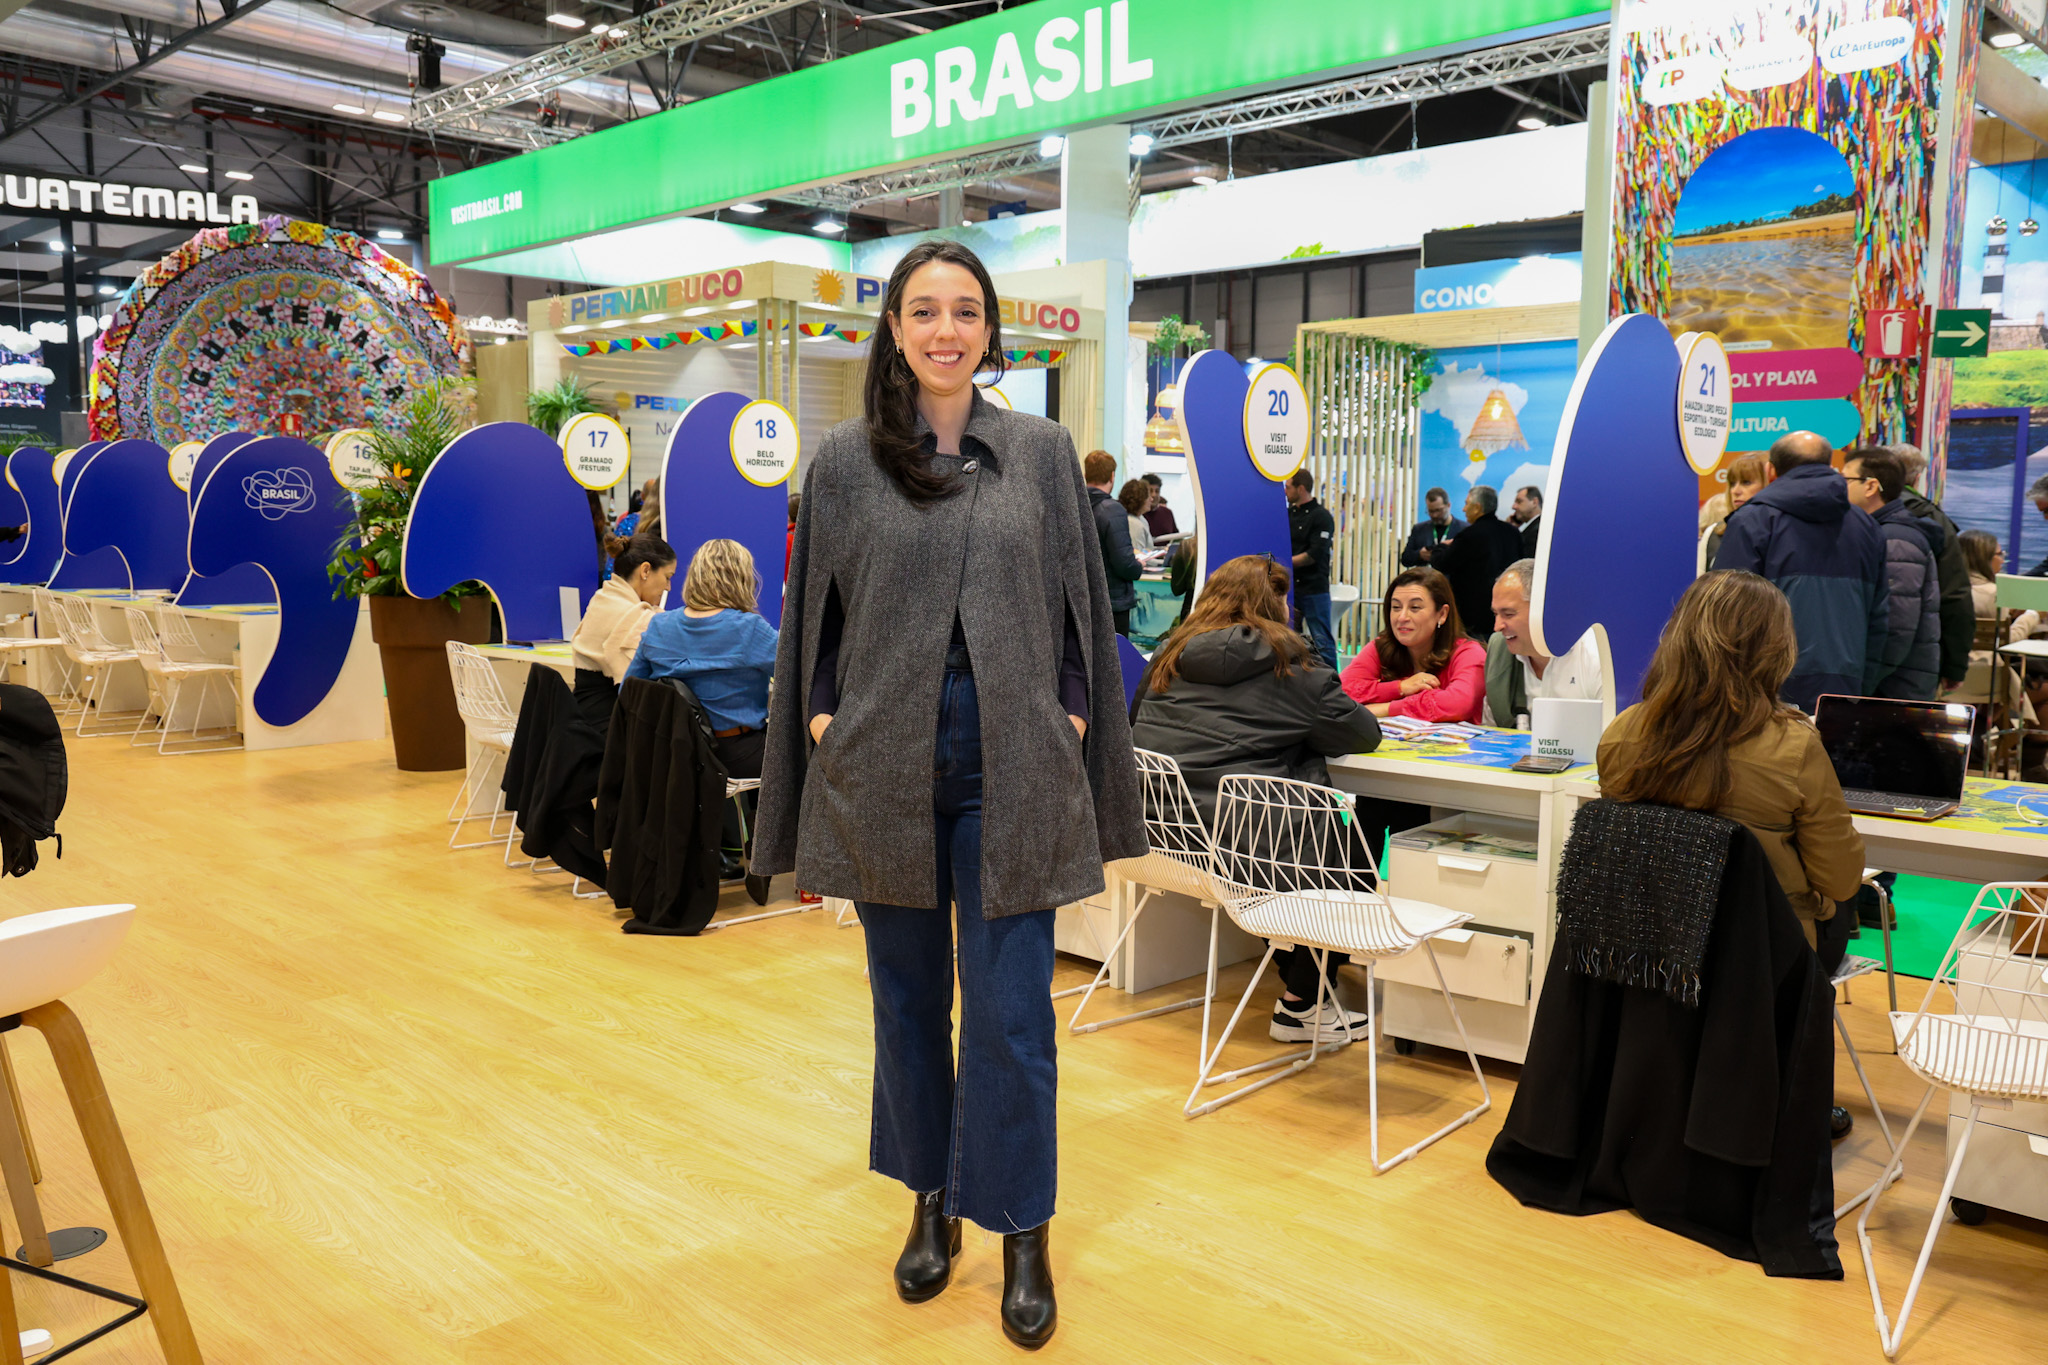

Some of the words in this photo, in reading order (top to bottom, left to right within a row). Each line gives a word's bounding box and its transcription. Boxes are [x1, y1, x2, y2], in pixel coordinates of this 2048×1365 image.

[891, 0, 1154, 138] BRASIL
[0, 174, 259, 224] UATEMALA
[451, 190, 523, 225] VISITBRASIL.COM
[571, 269, 744, 322] PERNAMBUCO
[1699, 363, 1716, 397] 21
[1731, 373, 1752, 389] OL
[1753, 372, 1765, 387] Y
[1766, 369, 1818, 387] PLAYA
[1268, 389, 1290, 417] 20
[755, 419, 777, 439] 18
[1730, 416, 1789, 433] ULTURA
[588, 430, 609, 448] 17
[1270, 432, 1287, 443] VISIT
[353, 444, 371, 460] 16
[757, 450, 775, 458] BELO
[1264, 444, 1293, 455] IGUASSU
[577, 463, 612, 473] /FESTURIS
[579, 456, 613, 465] GRAMADO
[746, 458, 785, 468] HORIZONTE
[262, 488, 300, 500] BRASIL
[1538, 738, 1560, 747] VISIT
[1537, 747, 1574, 756] IGUASSU
